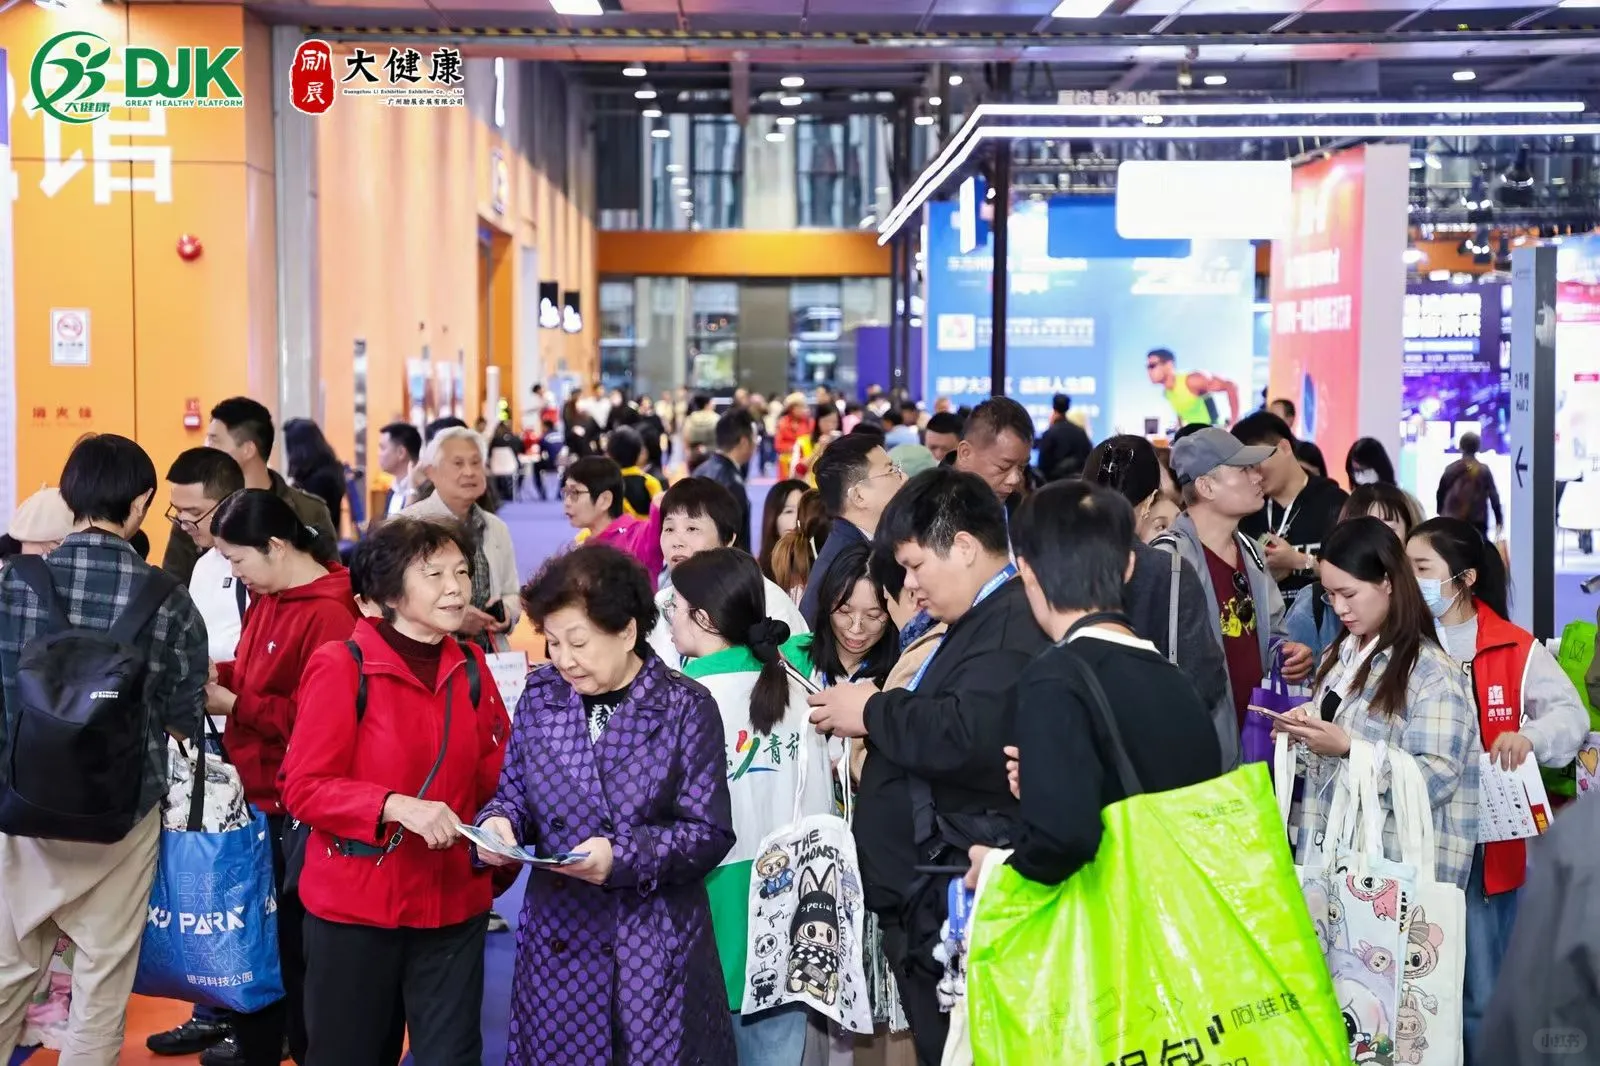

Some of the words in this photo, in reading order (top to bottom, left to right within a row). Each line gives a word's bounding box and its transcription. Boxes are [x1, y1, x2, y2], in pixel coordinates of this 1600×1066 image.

[790, 829, 819, 856] THE
[179, 906, 245, 935] PARK
[187, 972, 253, 987] 银河科技公园
